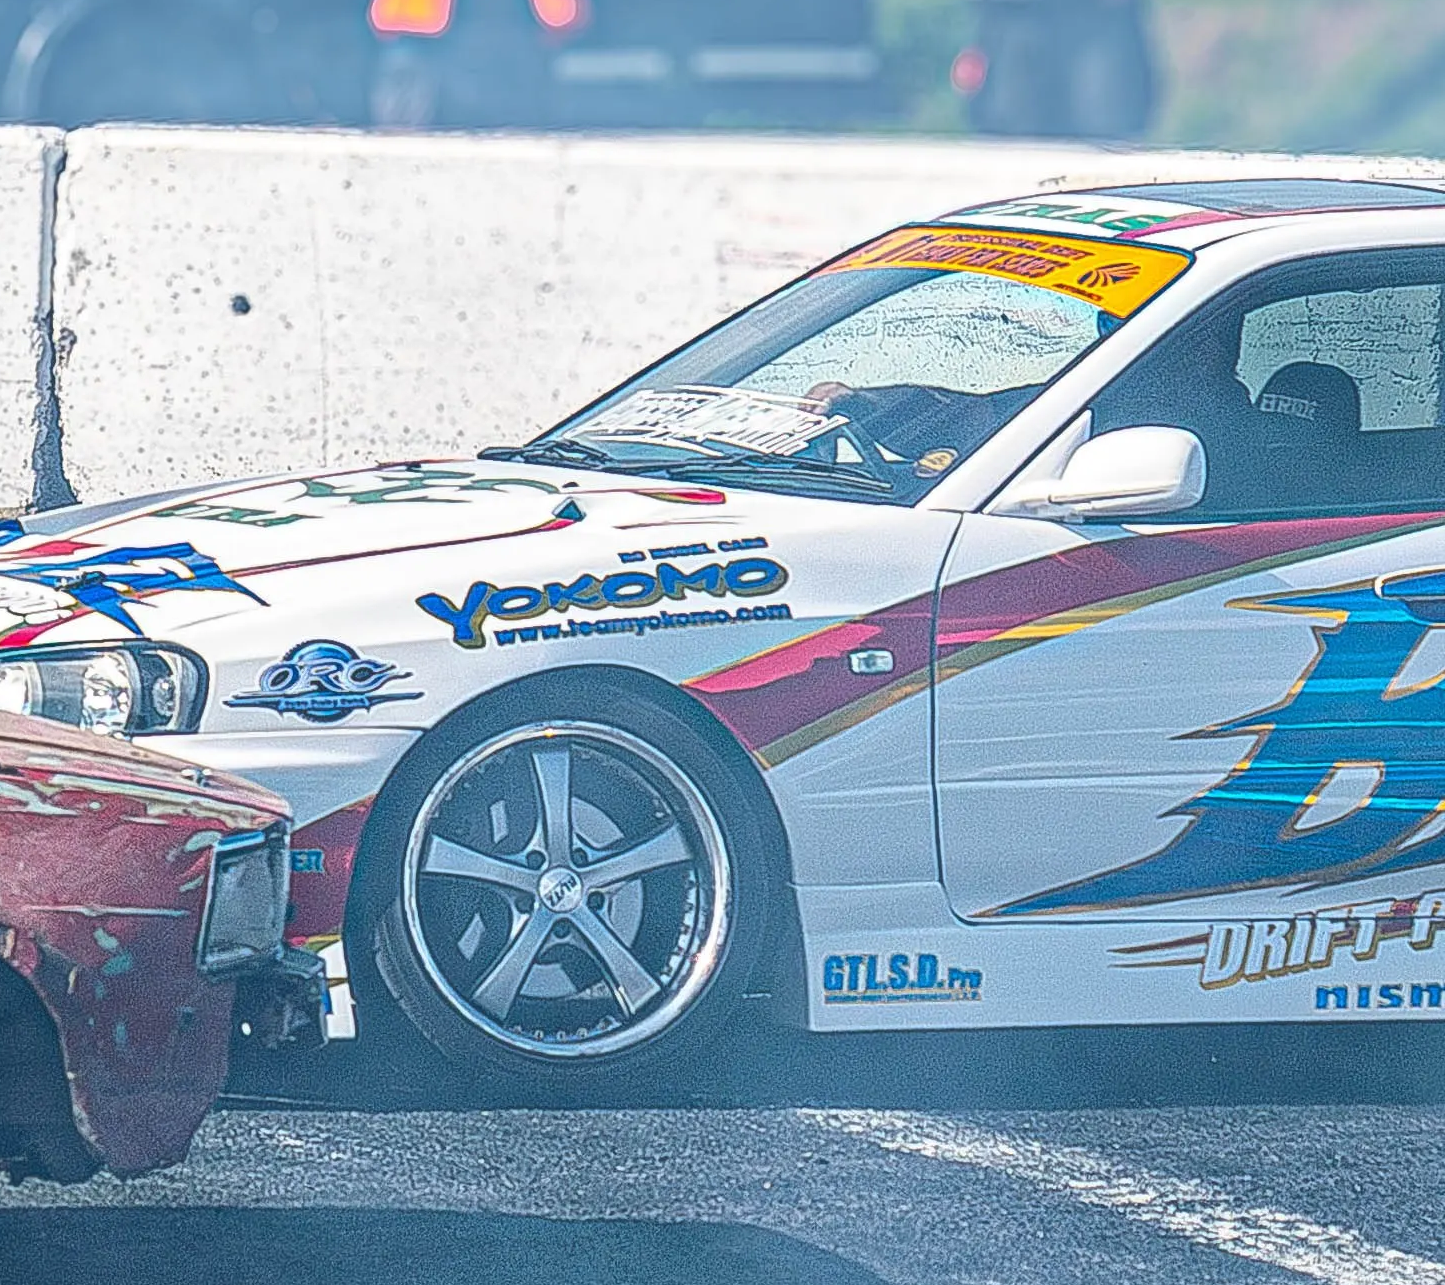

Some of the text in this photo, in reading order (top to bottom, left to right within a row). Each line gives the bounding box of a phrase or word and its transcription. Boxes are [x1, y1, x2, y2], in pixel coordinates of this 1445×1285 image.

[415, 556, 790, 650] YOKOMO
[258, 658, 414, 694] ORC
[1200, 902, 1393, 991] DRIFT
